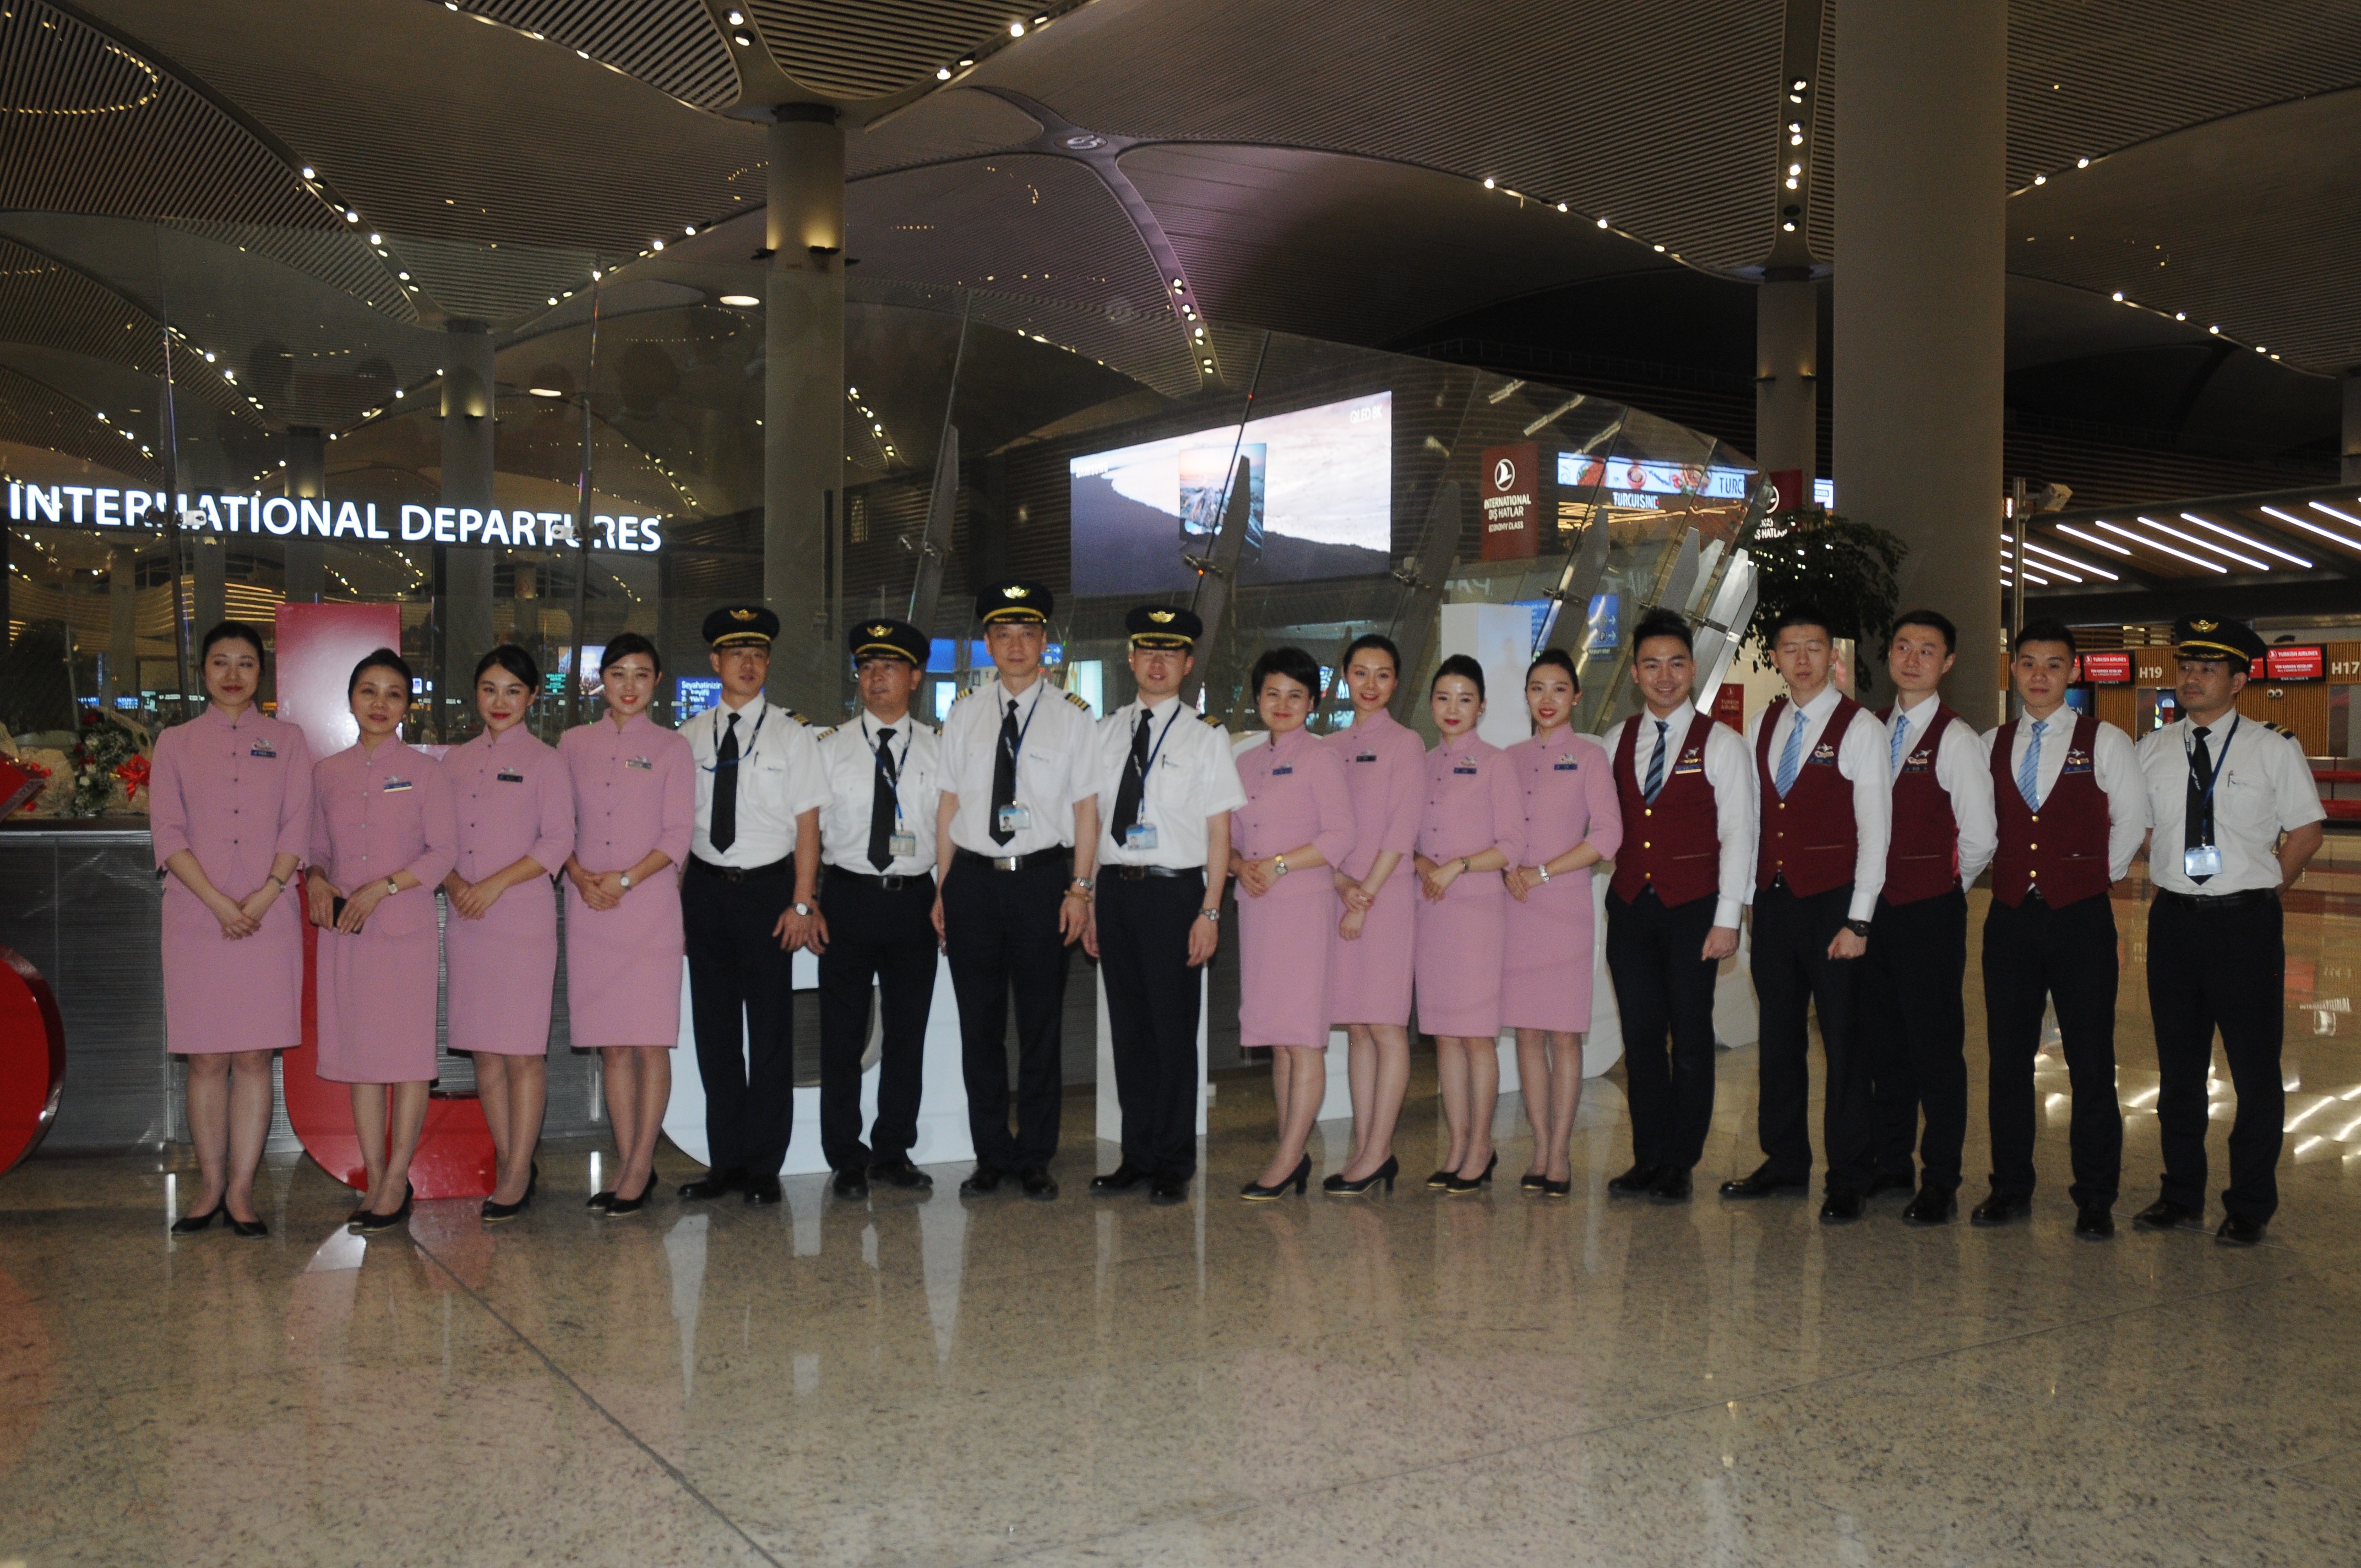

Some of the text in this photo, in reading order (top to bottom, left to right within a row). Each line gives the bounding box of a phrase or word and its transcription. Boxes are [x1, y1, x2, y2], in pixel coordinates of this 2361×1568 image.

[1350, 404, 1383, 423] QLED 8K
[1484, 493, 1532, 510] INTERNATIONAL
[1613, 492, 1659, 510] TURCUISINE
[1498, 505, 1524, 519] HATLAR
[1488, 520, 1524, 533] ECONOMY CLASS
[2139, 667, 2163, 679] H19
[2332, 661, 2360, 674] H17
